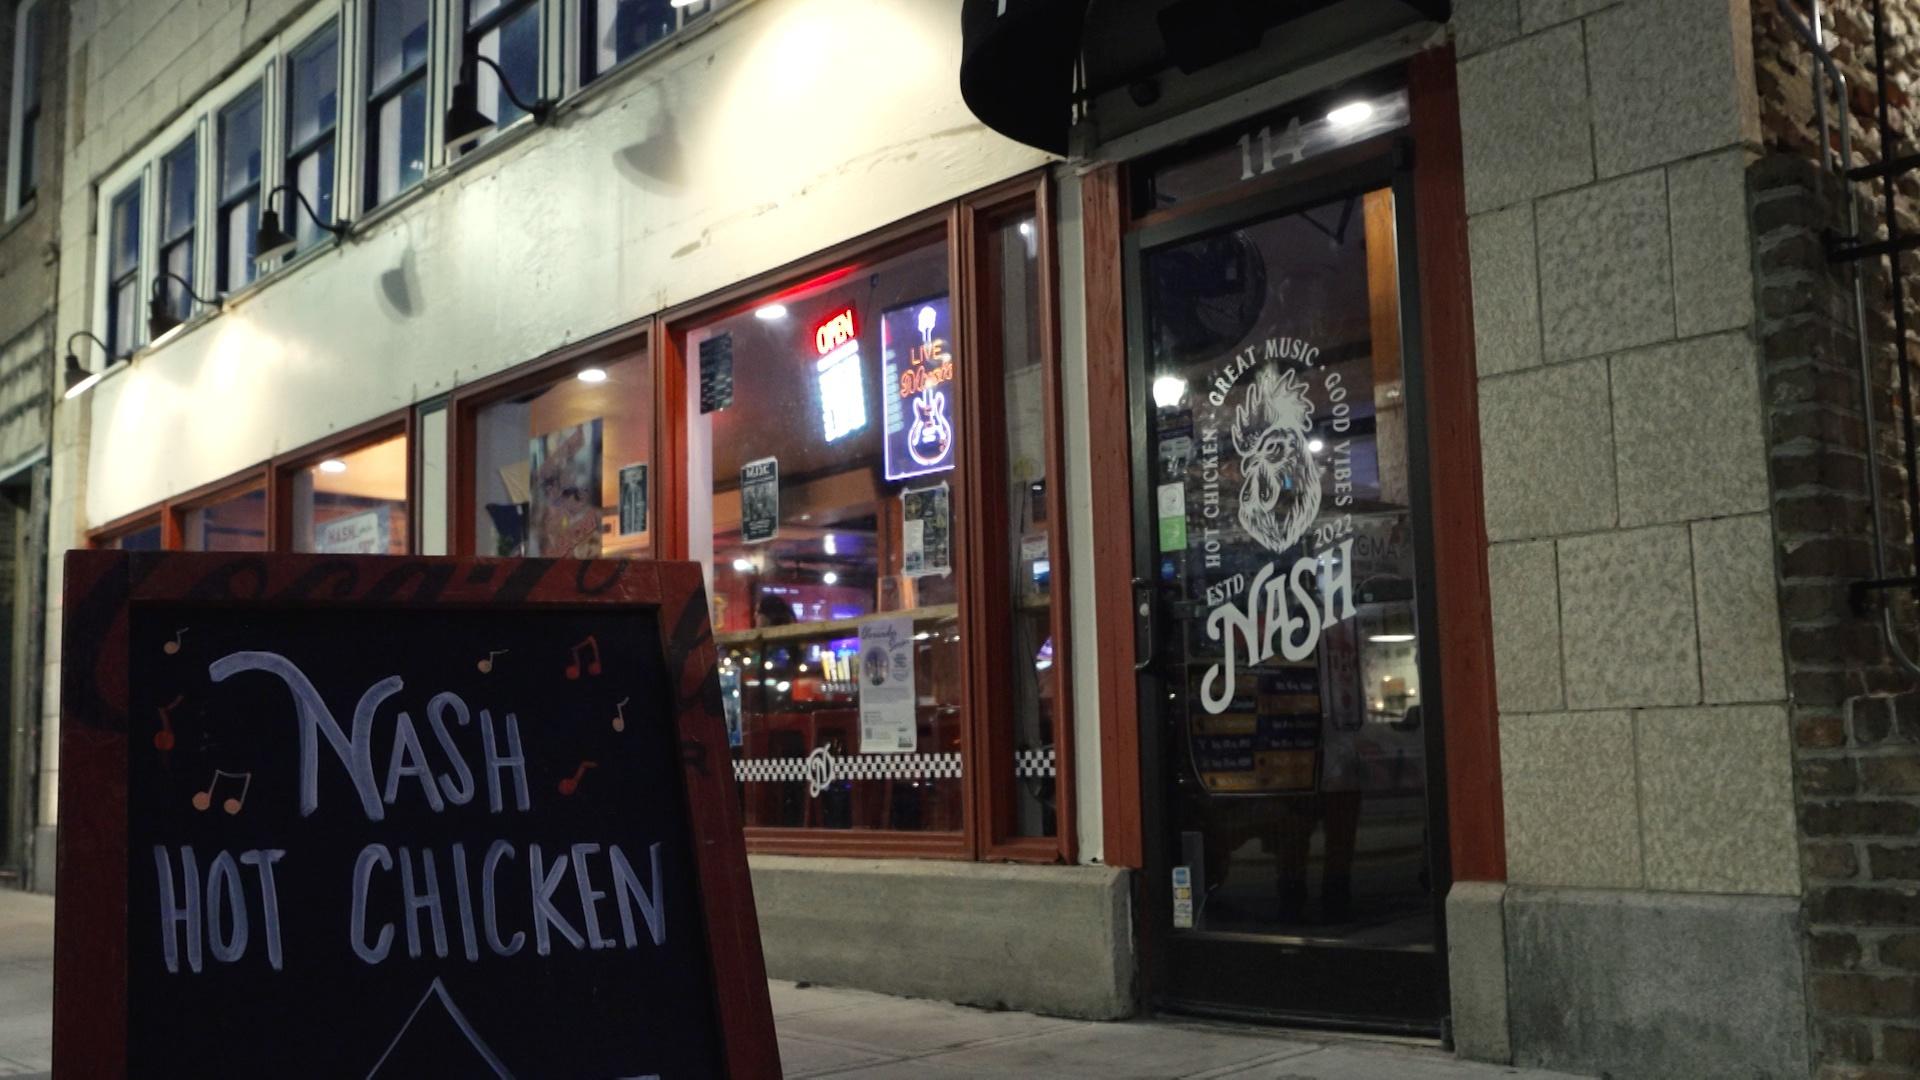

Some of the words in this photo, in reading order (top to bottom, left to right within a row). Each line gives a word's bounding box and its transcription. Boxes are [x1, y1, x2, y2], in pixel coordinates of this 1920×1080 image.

[1236, 117, 1302, 181] 114
[816, 309, 855, 354] OPEN
[911, 338, 943, 366] LIVE
[1264, 337, 1319, 367] MUSIC
[1208, 346, 1257, 407] GREAT
[1325, 373, 1350, 432] GOOD
[1202, 428, 1219, 518] CHICKEN
[1333, 440, 1352, 506] VIBES
[1205, 528, 1221, 568] HOT
[1206, 573, 1244, 606] ESTD
[1314, 514, 1354, 548] 2022
[1201, 538, 1357, 714] NASH
[208, 650, 532, 821] NASH
[153, 844, 286, 973] HOT
[350, 841, 667, 964] CHICKEN
